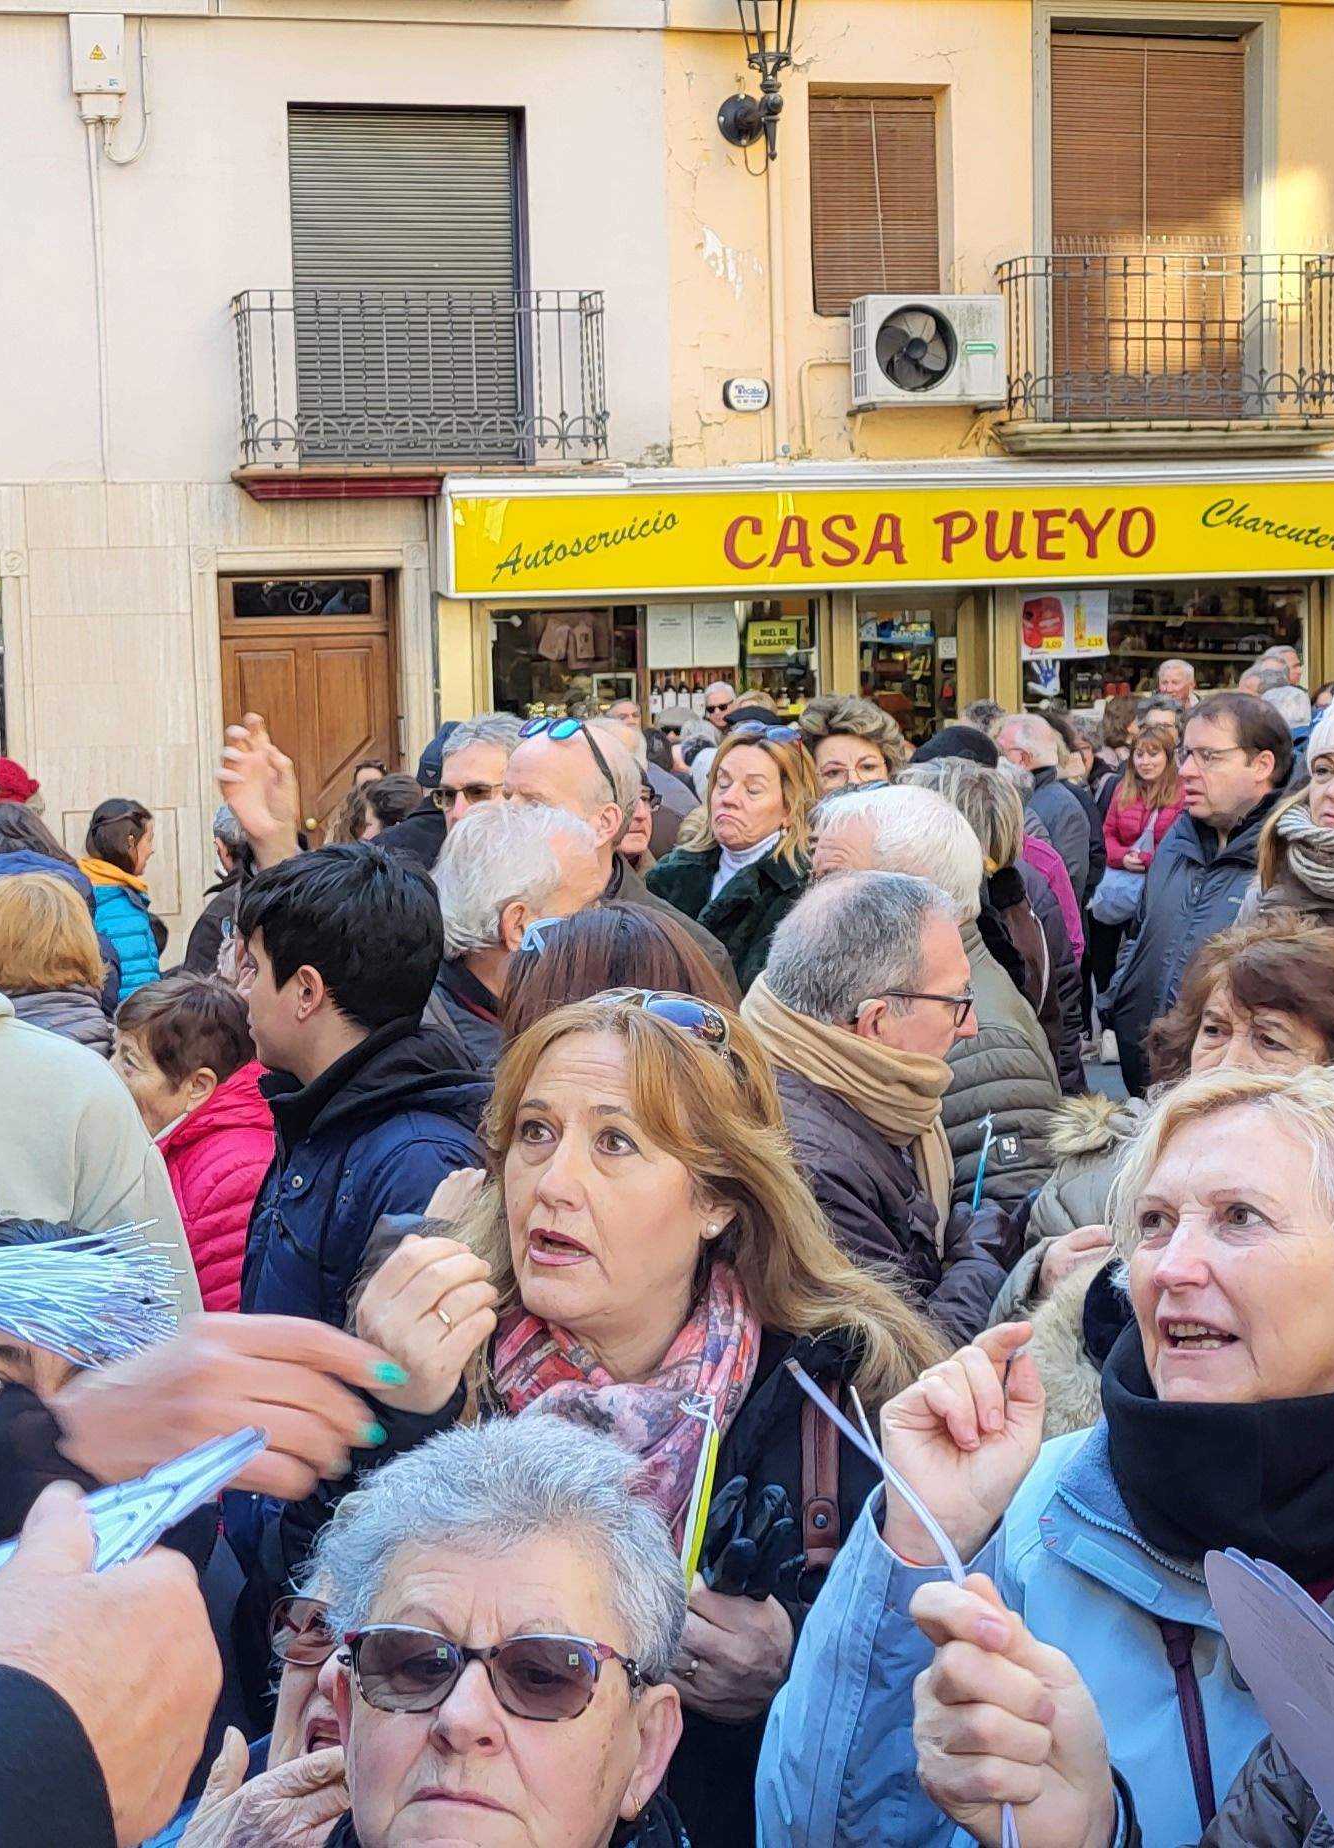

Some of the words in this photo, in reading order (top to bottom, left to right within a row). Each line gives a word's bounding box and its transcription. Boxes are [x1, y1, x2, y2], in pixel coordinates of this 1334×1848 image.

[491, 509, 679, 584] Autoservicio
[723, 512, 908, 570] CASA
[933, 506, 1157, 563] PUEYO
